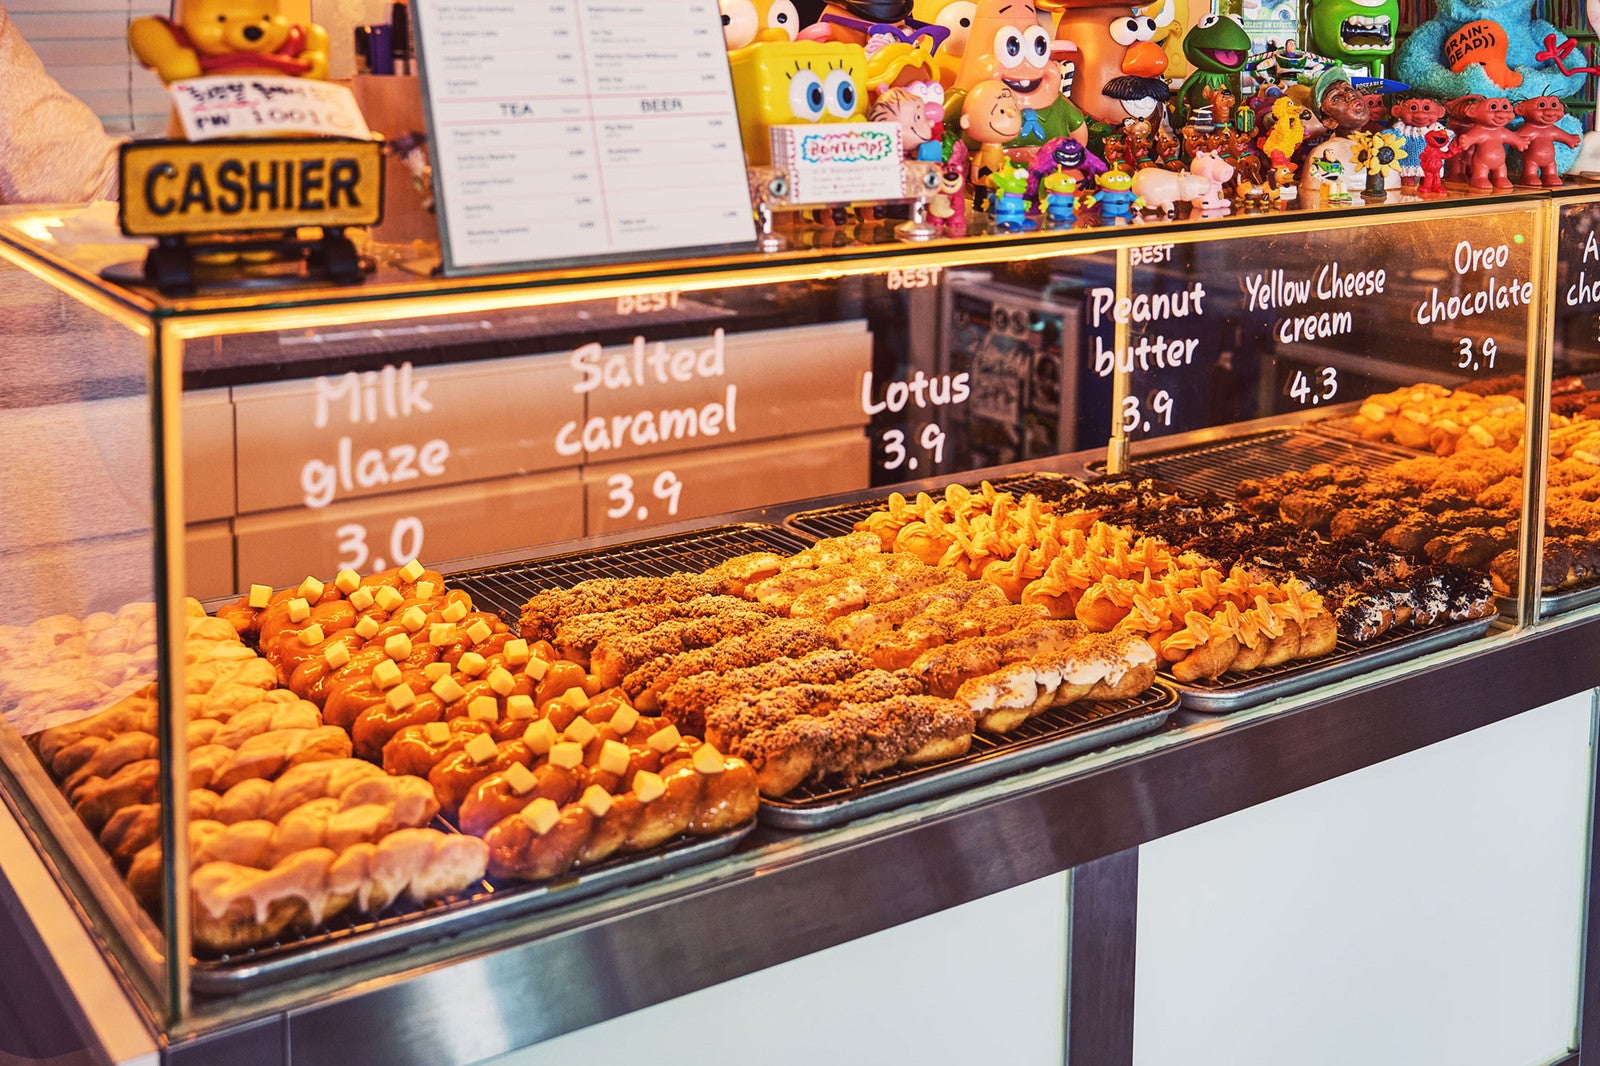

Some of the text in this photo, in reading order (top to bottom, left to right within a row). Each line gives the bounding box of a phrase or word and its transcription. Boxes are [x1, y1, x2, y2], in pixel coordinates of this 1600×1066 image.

[500, 103, 534, 116] TEA
[640, 98, 683, 113] BEER
[144, 157, 362, 216] CASHIER
[887, 266, 943, 290] BEST
[1129, 243, 1175, 267] BEST
[1454, 240, 1509, 276] Oreo
[617, 289, 680, 316] BEST
[1091, 281, 1206, 328] Peanut
[1246, 261, 1386, 313] Yellow Cheese
[1418, 276, 1534, 326] chocolate
[1280, 311, 1352, 345] cream
[570, 326, 726, 395] Salted
[1094, 335, 1200, 378] butter
[1457, 337, 1498, 371] 3.9
[314, 361, 434, 428] Milk
[861, 370, 970, 416] Lotus
[1289, 366, 1338, 406] 4.3
[554, 383, 738, 457] caramel
[1121, 389, 1174, 434] 3.9
[882, 423, 946, 471] 3.9
[300, 435, 450, 509] glaze
[606, 469, 683, 522] 3.9
[335, 516, 425, 573] 3.0
